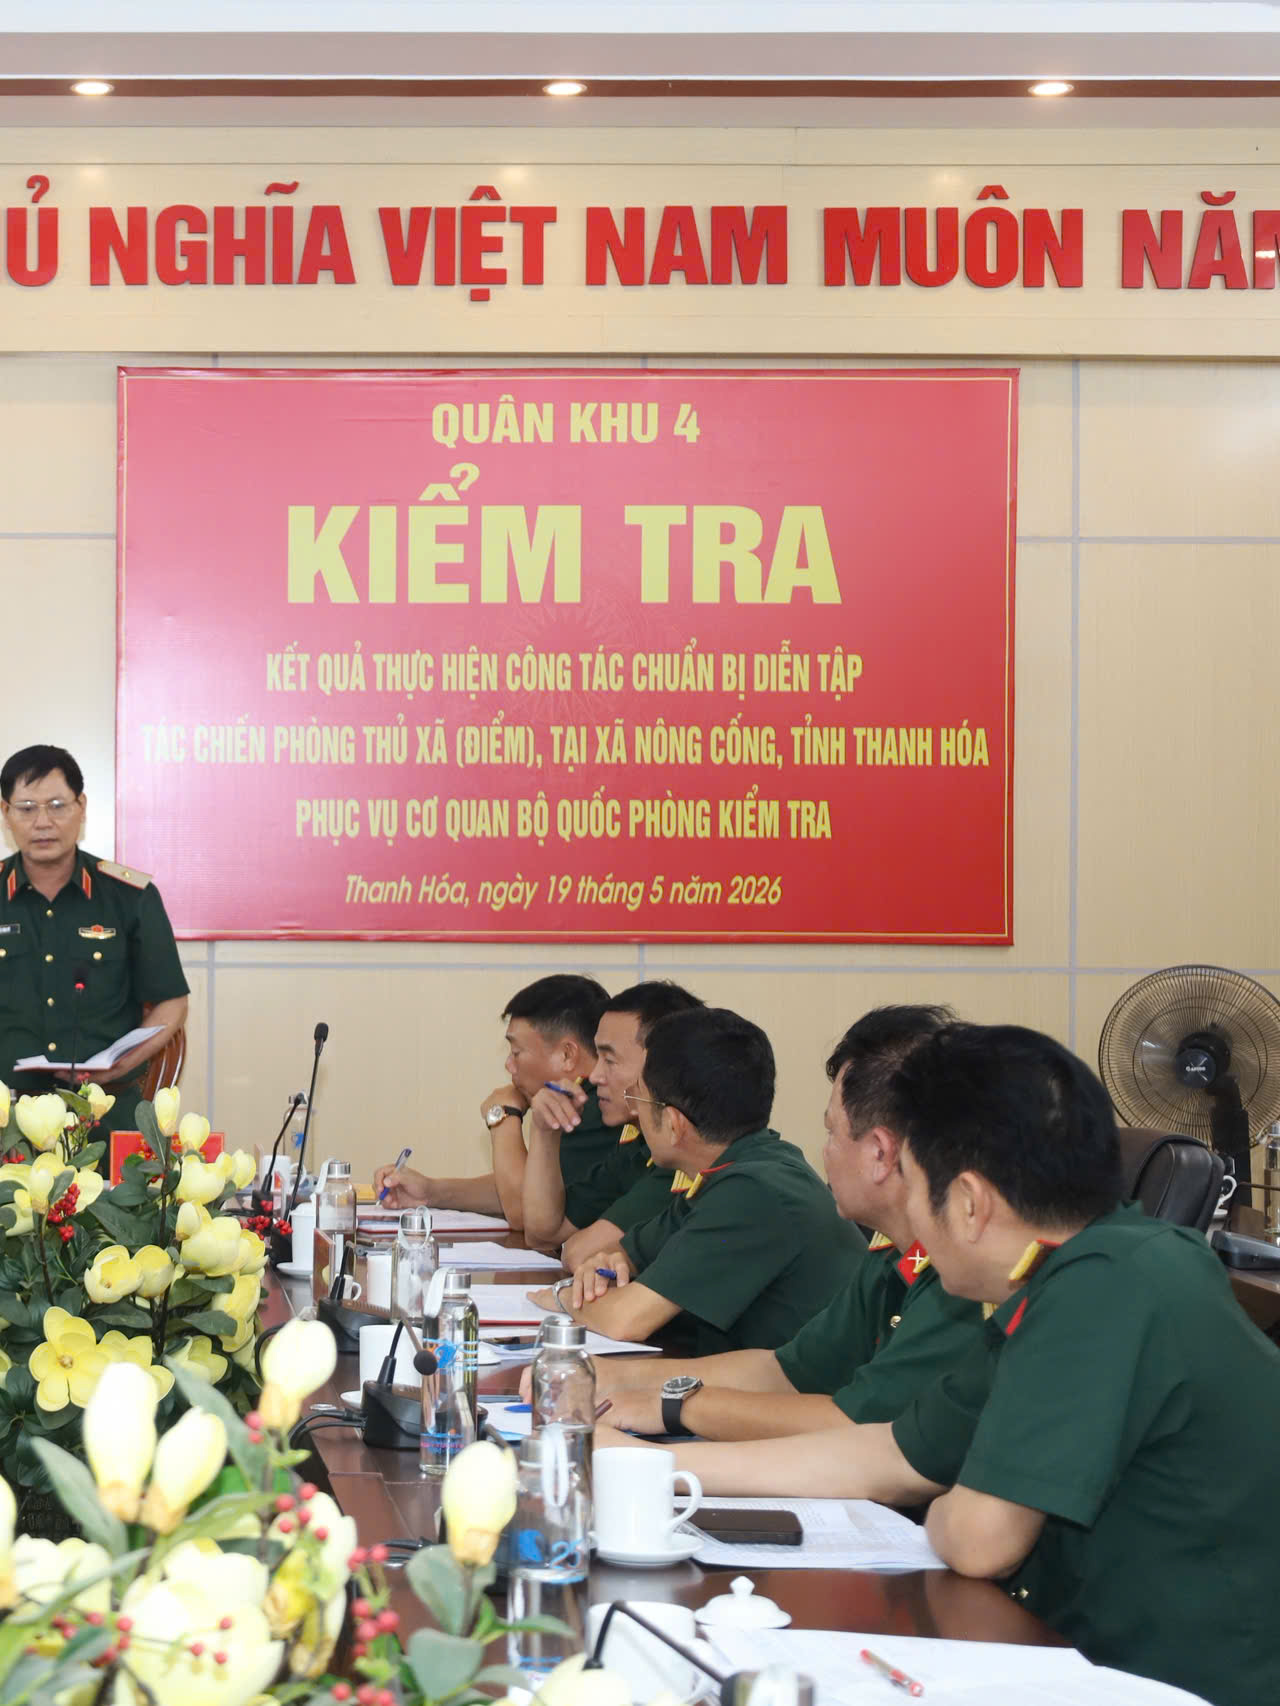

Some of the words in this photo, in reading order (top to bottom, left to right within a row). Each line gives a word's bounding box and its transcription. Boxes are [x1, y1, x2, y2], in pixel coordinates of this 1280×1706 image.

[89, 181, 356, 286] NGHĨA
[379, 185, 557, 301] VIỆT
[585, 205, 788, 286] NAM
[824, 185, 1084, 287] MUÔN
[431, 394, 554, 449] QUÂN
[570, 402, 659, 444] KHU
[673, 403, 701, 443] 4
[287, 463, 583, 605] KIỂM
[623, 504, 843, 605] TRA
[266, 640, 310, 691] KẾT
[317, 640, 366, 695] QUẢ
[372, 649, 434, 700] THỰC
[442, 645, 498, 701] HIỆN
[506, 644, 572, 692] CÔNG
[579, 645, 625, 692] TÁC
[632, 637, 715, 692] CHUẨN
[722, 652, 746, 701] BỊ
[754, 640, 810, 692] DIỄN
[817, 645, 863, 702] TẬP
[142, 716, 186, 764] TÁC
[194, 713, 266, 764] CHIẾN
[273, 716, 356, 764] PHÒNG
[362, 712, 408, 764] THỦ
[415, 718, 448, 764] XÃ
[456, 710, 543, 768] (ĐIỂM),
[550, 725, 587, 773] TẠI
[595, 718, 628, 764] XÃ
[635, 717, 703, 764] NÔNG
[710, 712, 783, 770] CỐNG,
[790, 713, 846, 765] TỈNH
[853, 727, 933, 766] THANH
[940, 719, 990, 766] HÓA
[296, 798, 360, 846] PHỤC
[368, 798, 398, 846] VỤ
[406, 795, 438, 838] CƠ
[445, 799, 510, 842] QUAN
[517, 791, 550, 846] BỘ
[557, 785, 621, 843] QUỐC
[628, 789, 711, 838] PHÒNG
[718, 784, 780, 838] KIỂM
[787, 800, 832, 839] TRA
[345, 874, 412, 904] Thanh
[418, 872, 470, 908] Hóa,
[478, 872, 538, 911] ngày
[547, 874, 572, 903] 19
[577, 872, 645, 912] tháng
[649, 875, 664, 904] 5
[669, 875, 722, 904] năm
[727, 875, 783, 904] 2026
